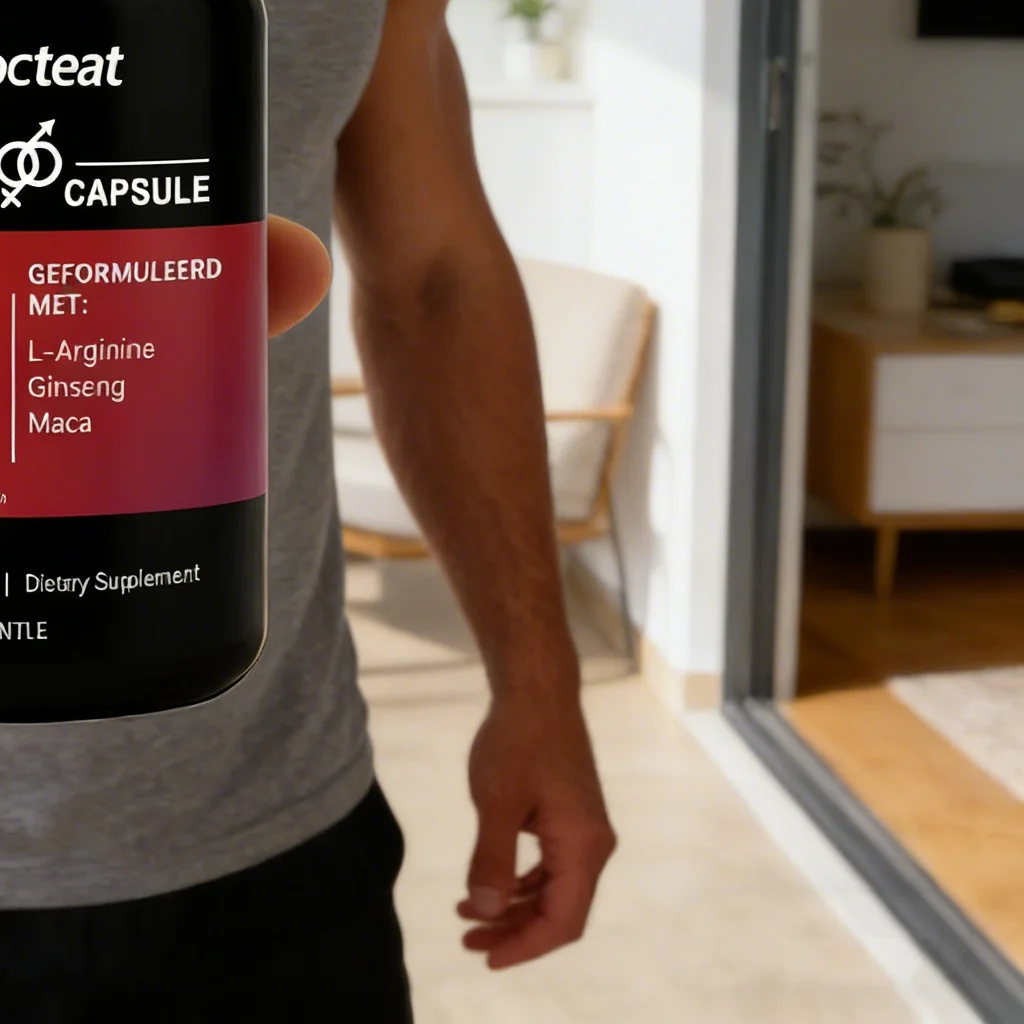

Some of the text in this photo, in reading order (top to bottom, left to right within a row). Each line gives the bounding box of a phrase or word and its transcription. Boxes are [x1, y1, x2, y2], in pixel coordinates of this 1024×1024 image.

[64, 174, 210, 207] CAPSULE
[28, 258, 223, 285] GEFORMULEERD
[29, 293, 88, 316] MET:
[28, 337, 155, 367] L-Arginine
[28, 376, 125, 402] Ginseng
[28, 412, 92, 434] Maca
[94, 564, 201, 595] Supplement
